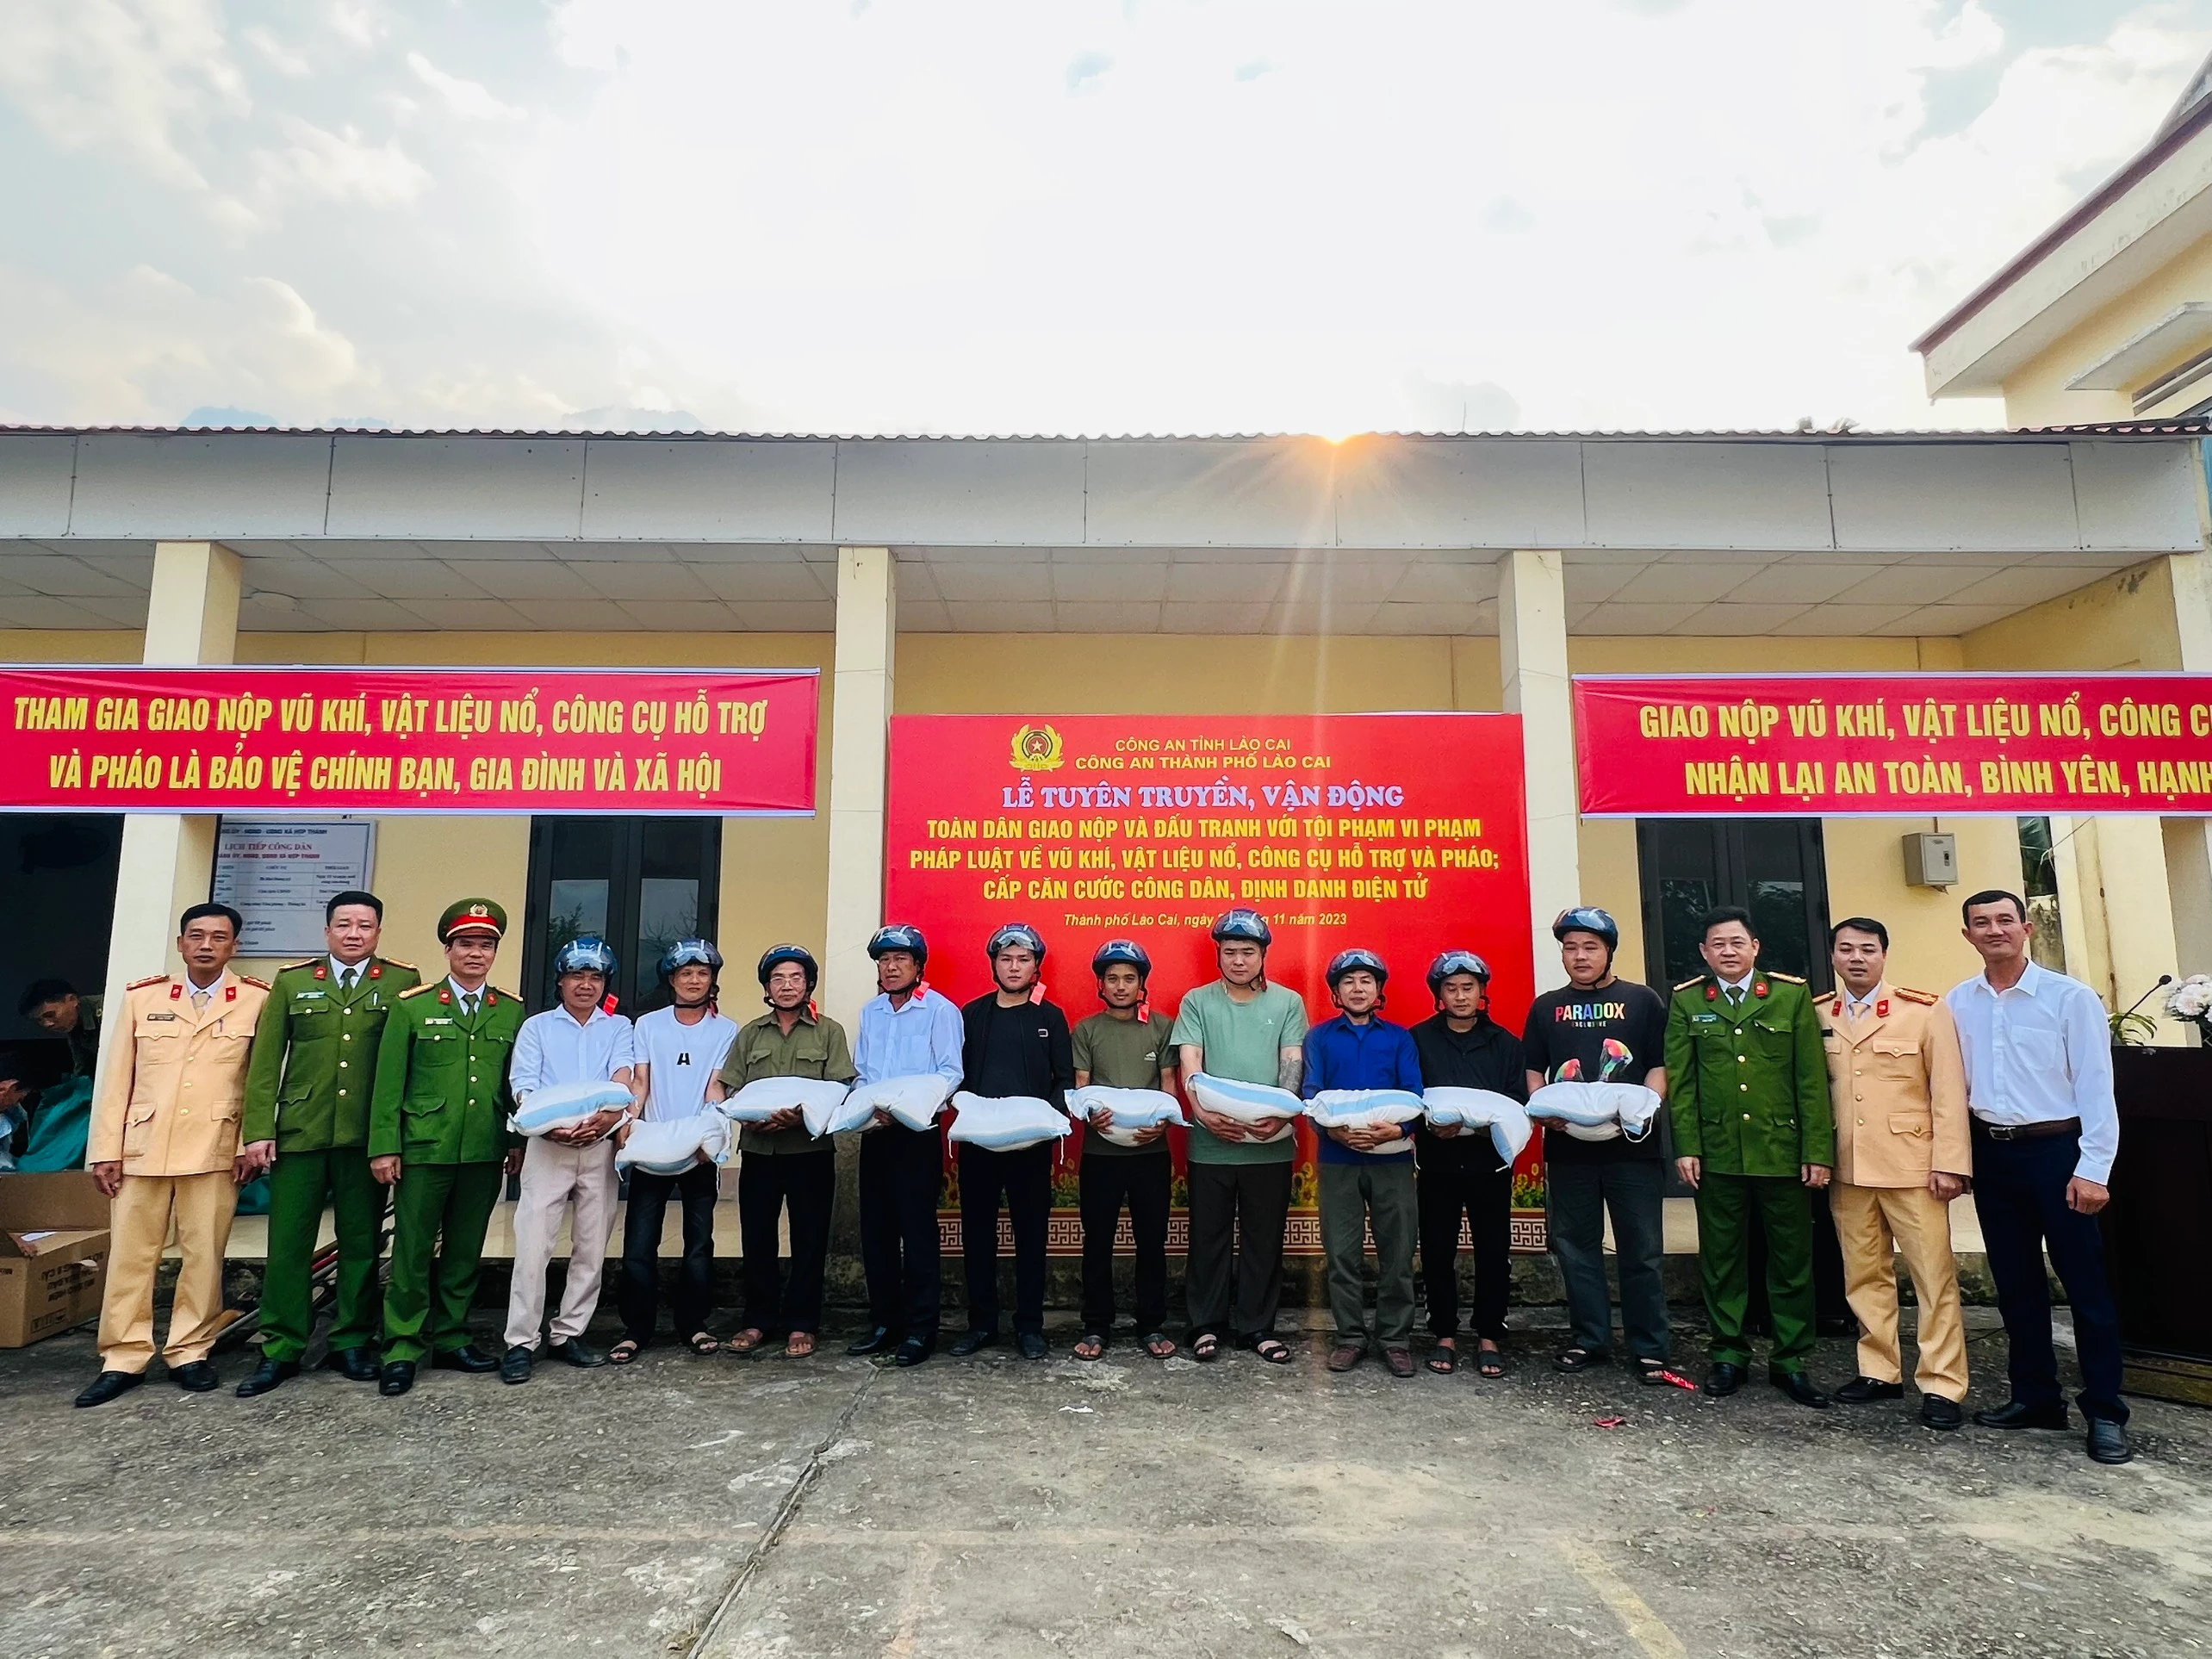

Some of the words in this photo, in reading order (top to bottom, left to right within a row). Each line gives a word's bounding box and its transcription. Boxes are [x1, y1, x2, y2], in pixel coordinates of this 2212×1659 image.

[13, 697, 89, 730] THAM
[94, 697, 139, 731] GIA
[146, 698, 210, 731] GIAO
[215, 691, 273, 739] NỘP
[279, 692, 314, 732] VŨ
[320, 692, 372, 736] KHÍ,
[381, 692, 430, 740] VẬT
[434, 693, 493, 740] LIỆU
[498, 687, 544, 738] NỔ,
[550, 693, 624, 734] CÔNG
[631, 700, 668, 742] CỤ
[673, 688, 710, 735] HỖ
[716, 699, 768, 742] TRỢ
[1638, 704, 1709, 738] GIAO
[1717, 698, 1780, 745] NỘP
[1786, 698, 1827, 738] VŨ
[1834, 697, 1895, 742] KHÍ,
[1901, 697, 1957, 744] VẬT
[1965, 697, 2030, 744] LIỆU
[2038, 691, 2091, 741] NỔ,
[2098, 697, 2181, 736] CÔNG
[2189, 704, 2212, 737] C
[1114, 736, 1160, 752] CÔNG
[1163, 739, 1186, 752] AN
[1189, 735, 1225, 751] TỈNH
[1228, 735, 1261, 751] LÀO
[1264, 738, 1290, 751] CAI
[49, 748, 82, 789] VÀ
[89, 748, 163, 789] PHÁO
[168, 749, 201, 789] LÀ
[208, 742, 264, 790] BẢO
[270, 749, 303, 798] VỆ
[308, 749, 392, 790] CHÍNH
[397, 756, 461, 798] BẠN,
[469, 756, 513, 791] GIA
[520, 750, 586, 792] ĐÌNH
[593, 750, 626, 792] VÀ
[633, 751, 669, 792] XÃ
[676, 751, 721, 799] HỘI
[1074, 754, 1124, 770] CÔNG
[1128, 756, 1154, 769] AN
[1158, 753, 1218, 769] THÀNH
[1221, 751, 1258, 768] PHỐ
[1262, 753, 1297, 768] LÀO
[1301, 755, 1331, 768] CAI
[1001, 776, 1035, 808] LỄ
[1039, 780, 1132, 808] TUYÊN
[1137, 774, 1255, 811] TRUYỀN,
[1260, 779, 1321, 812] VẬN
[1326, 779, 1404, 812] ĐỘNG
[1684, 755, 1770, 802] NHẬN
[1776, 761, 1825, 802] LẠI
[1833, 761, 1877, 794] AN
[1881, 754, 1973, 798] TOÀN,
[1979, 754, 2054, 794] BÌNH
[2059, 754, 2130, 798] YÊN,
[2135, 761, 2212, 801] HẠNH
[926, 816, 977, 839] TOÀN
[982, 816, 1022, 839] DÂN
[1027, 819, 1073, 839] GIAO
[1078, 816, 1119, 843] NỘP
[1122, 815, 1149, 838] VÀ
[1153, 812, 1193, 838] ĐẤU
[1196, 818, 1261, 838] TRANH
[1265, 813, 1297, 838] VỚI
[1302, 814, 1333, 842] TỘI
[1337, 818, 1395, 842] PHẠM
[1399, 818, 1419, 838] VI
[1423, 818, 1482, 842] PHẠM
[267, 842, 293, 851] CÔNG
[909, 846, 961, 869] PHÁP
[966, 846, 1014, 873] LUẬT
[1018, 843, 1042, 869] VỀ
[1047, 846, 1072, 869] VŨ
[1078, 846, 1116, 872] KHÍ,
[1120, 846, 1158, 873] VẬT
[1161, 845, 1203, 873] LIỆU
[1208, 842, 1242, 870] NỔ,
[1246, 844, 1301, 868] CÔNG
[1305, 848, 1333, 873] CỤ
[1337, 842, 1364, 868] HỖ
[1367, 848, 1407, 873] TRỢ
[1409, 845, 1437, 868] VÀ
[1440, 845, 1499, 870] PHÁO;
[982, 873, 1022, 900] CẤP
[1027, 876, 1068, 900] CĂN
[1072, 874, 1125, 900] CƯỚC
[1130, 875, 1184, 899] CÔNG
[1189, 875, 1235, 901] DÂN,
[1240, 879, 1288, 903] ĐỊNH
[1292, 879, 1346, 900] DANH
[1351, 875, 1398, 903] ĐIỆN
[1401, 871, 1427, 898] TỬ
[1063, 914, 1102, 926] Thành
[1103, 912, 1129, 929] phố
[1130, 913, 1154, 926] Lào
[1157, 913, 1180, 927] Cai,
[1183, 913, 1215, 929] ngày
[1272, 913, 1285, 925] 11
[1288, 913, 1315, 926] năm
[1317, 912, 1347, 925] 2023
[1555, 1003, 1625, 1022] PARADOX
